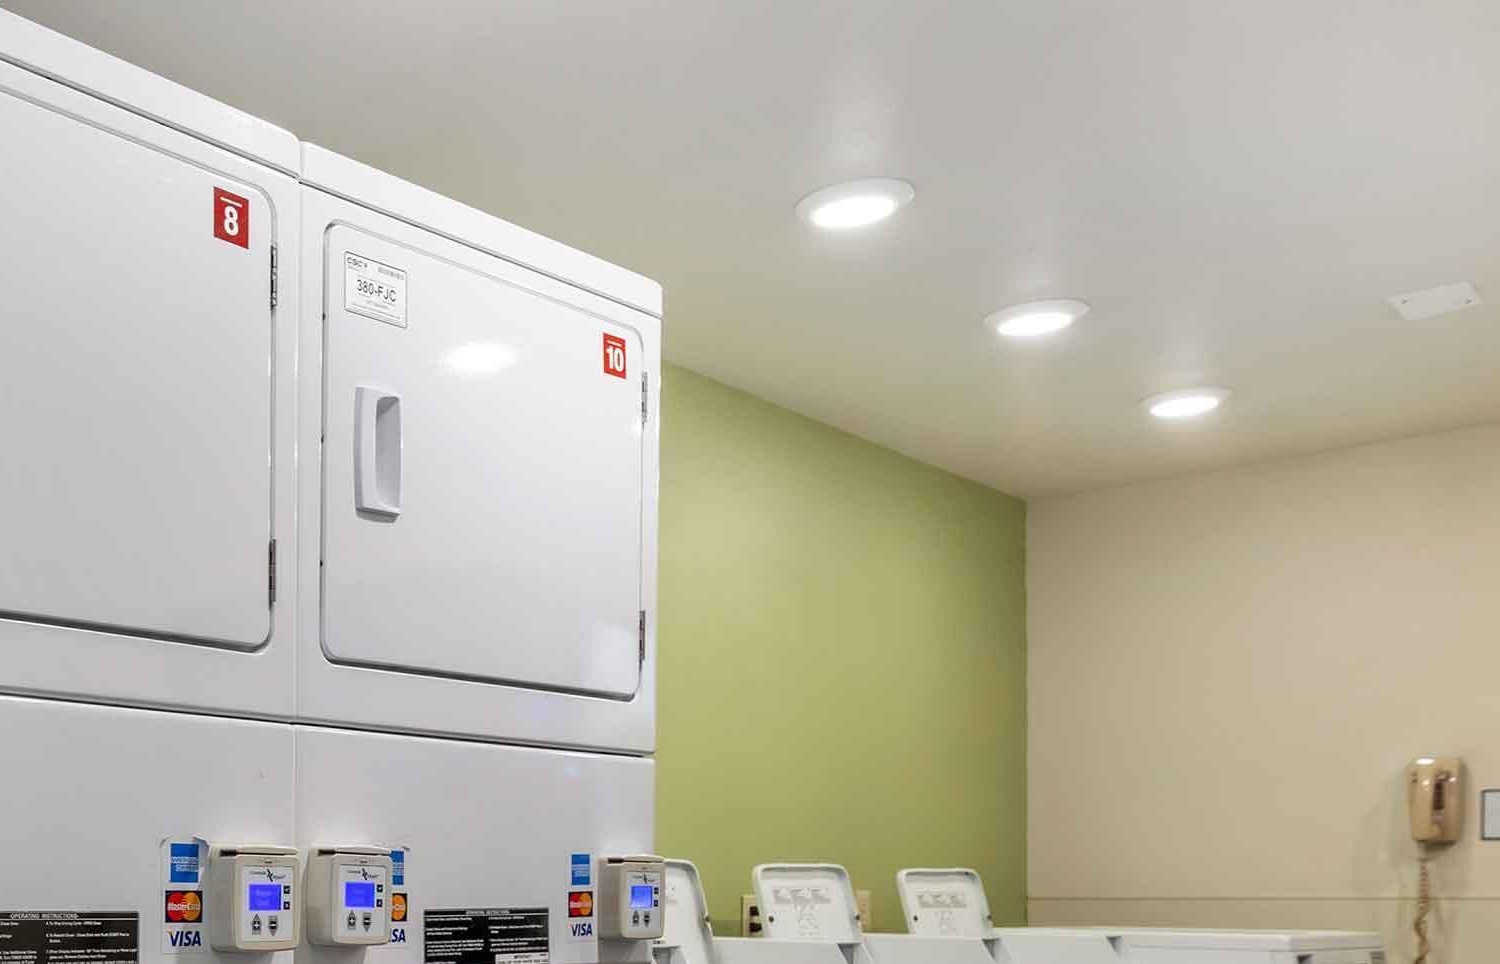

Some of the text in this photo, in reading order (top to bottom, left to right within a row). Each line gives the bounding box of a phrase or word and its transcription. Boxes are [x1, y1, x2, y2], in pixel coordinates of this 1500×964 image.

[224, 206, 239, 236] 8
[357, 279, 396, 302] 380-FJC
[606, 346, 624, 372] 10
[167, 930, 202, 947] VISA
[570, 923, 593, 936] VISA
